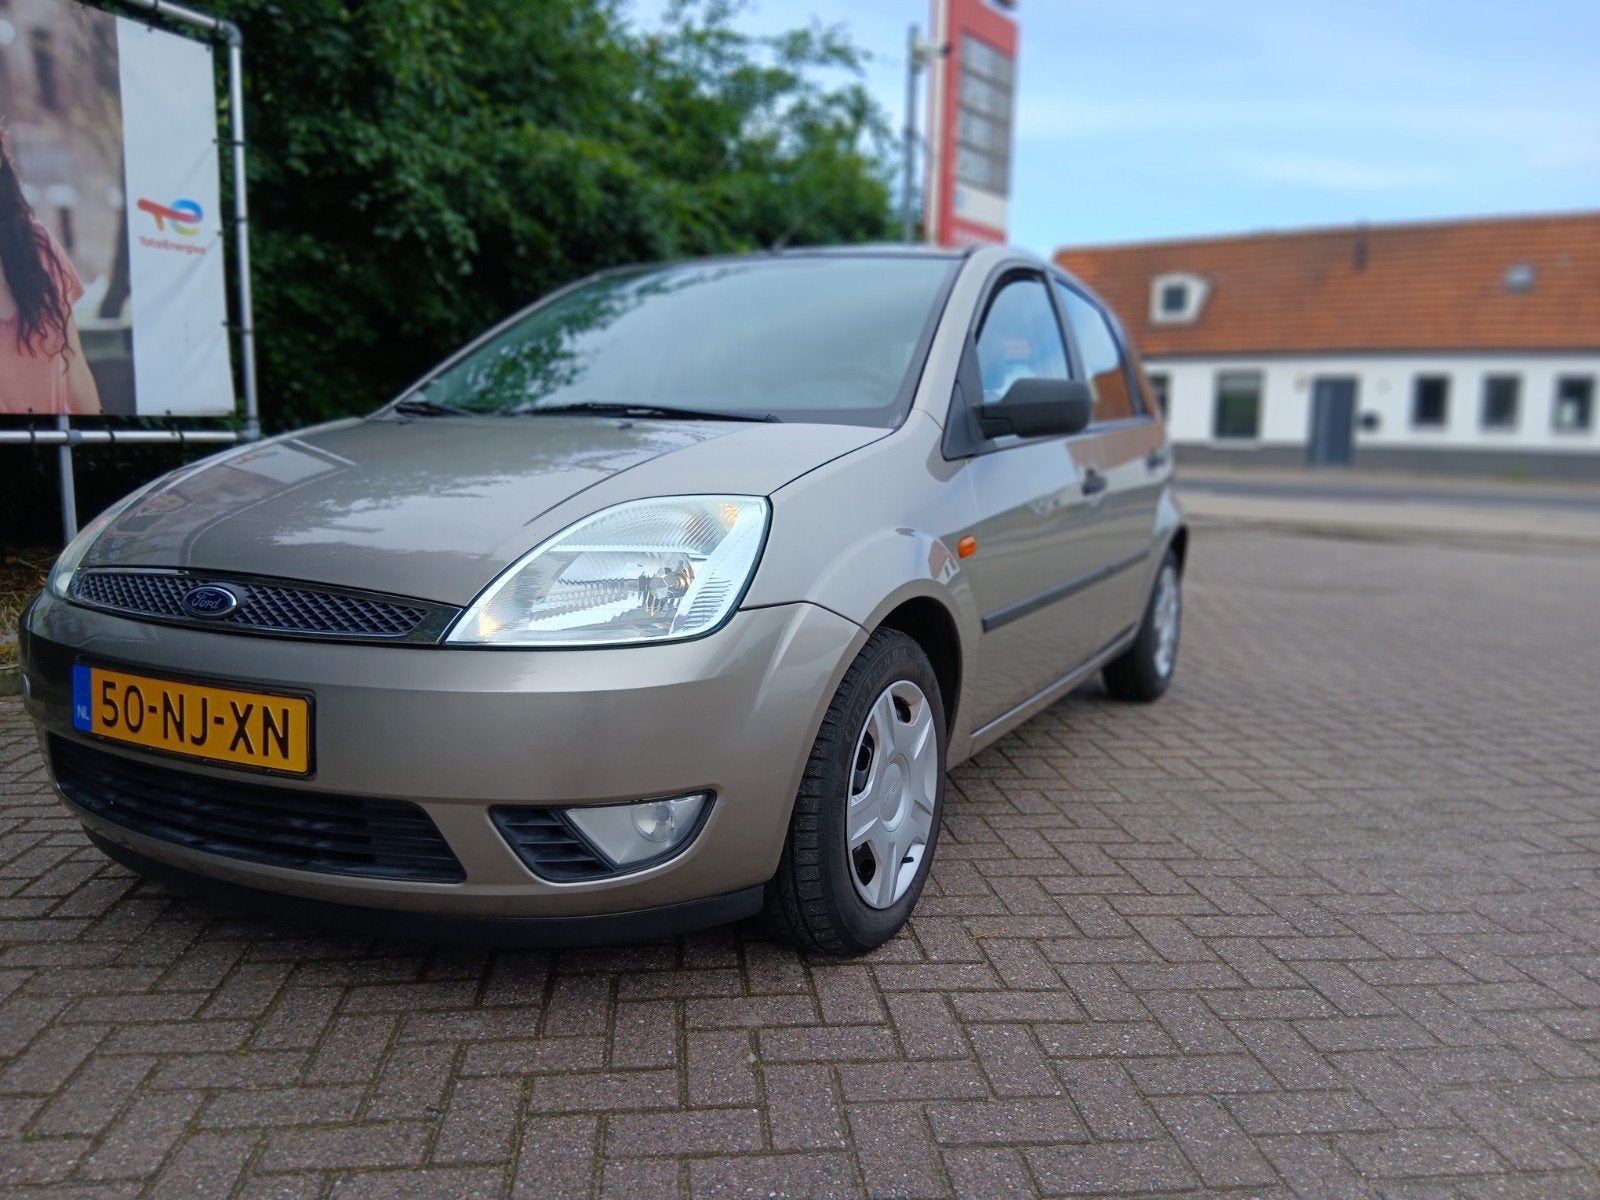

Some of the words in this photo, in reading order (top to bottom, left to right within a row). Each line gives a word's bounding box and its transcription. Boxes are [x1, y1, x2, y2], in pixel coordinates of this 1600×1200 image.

[191, 591, 223, 609] Ford
[77, 704, 90, 720] NL
[101, 679, 290, 760] 50-NJ-XN
